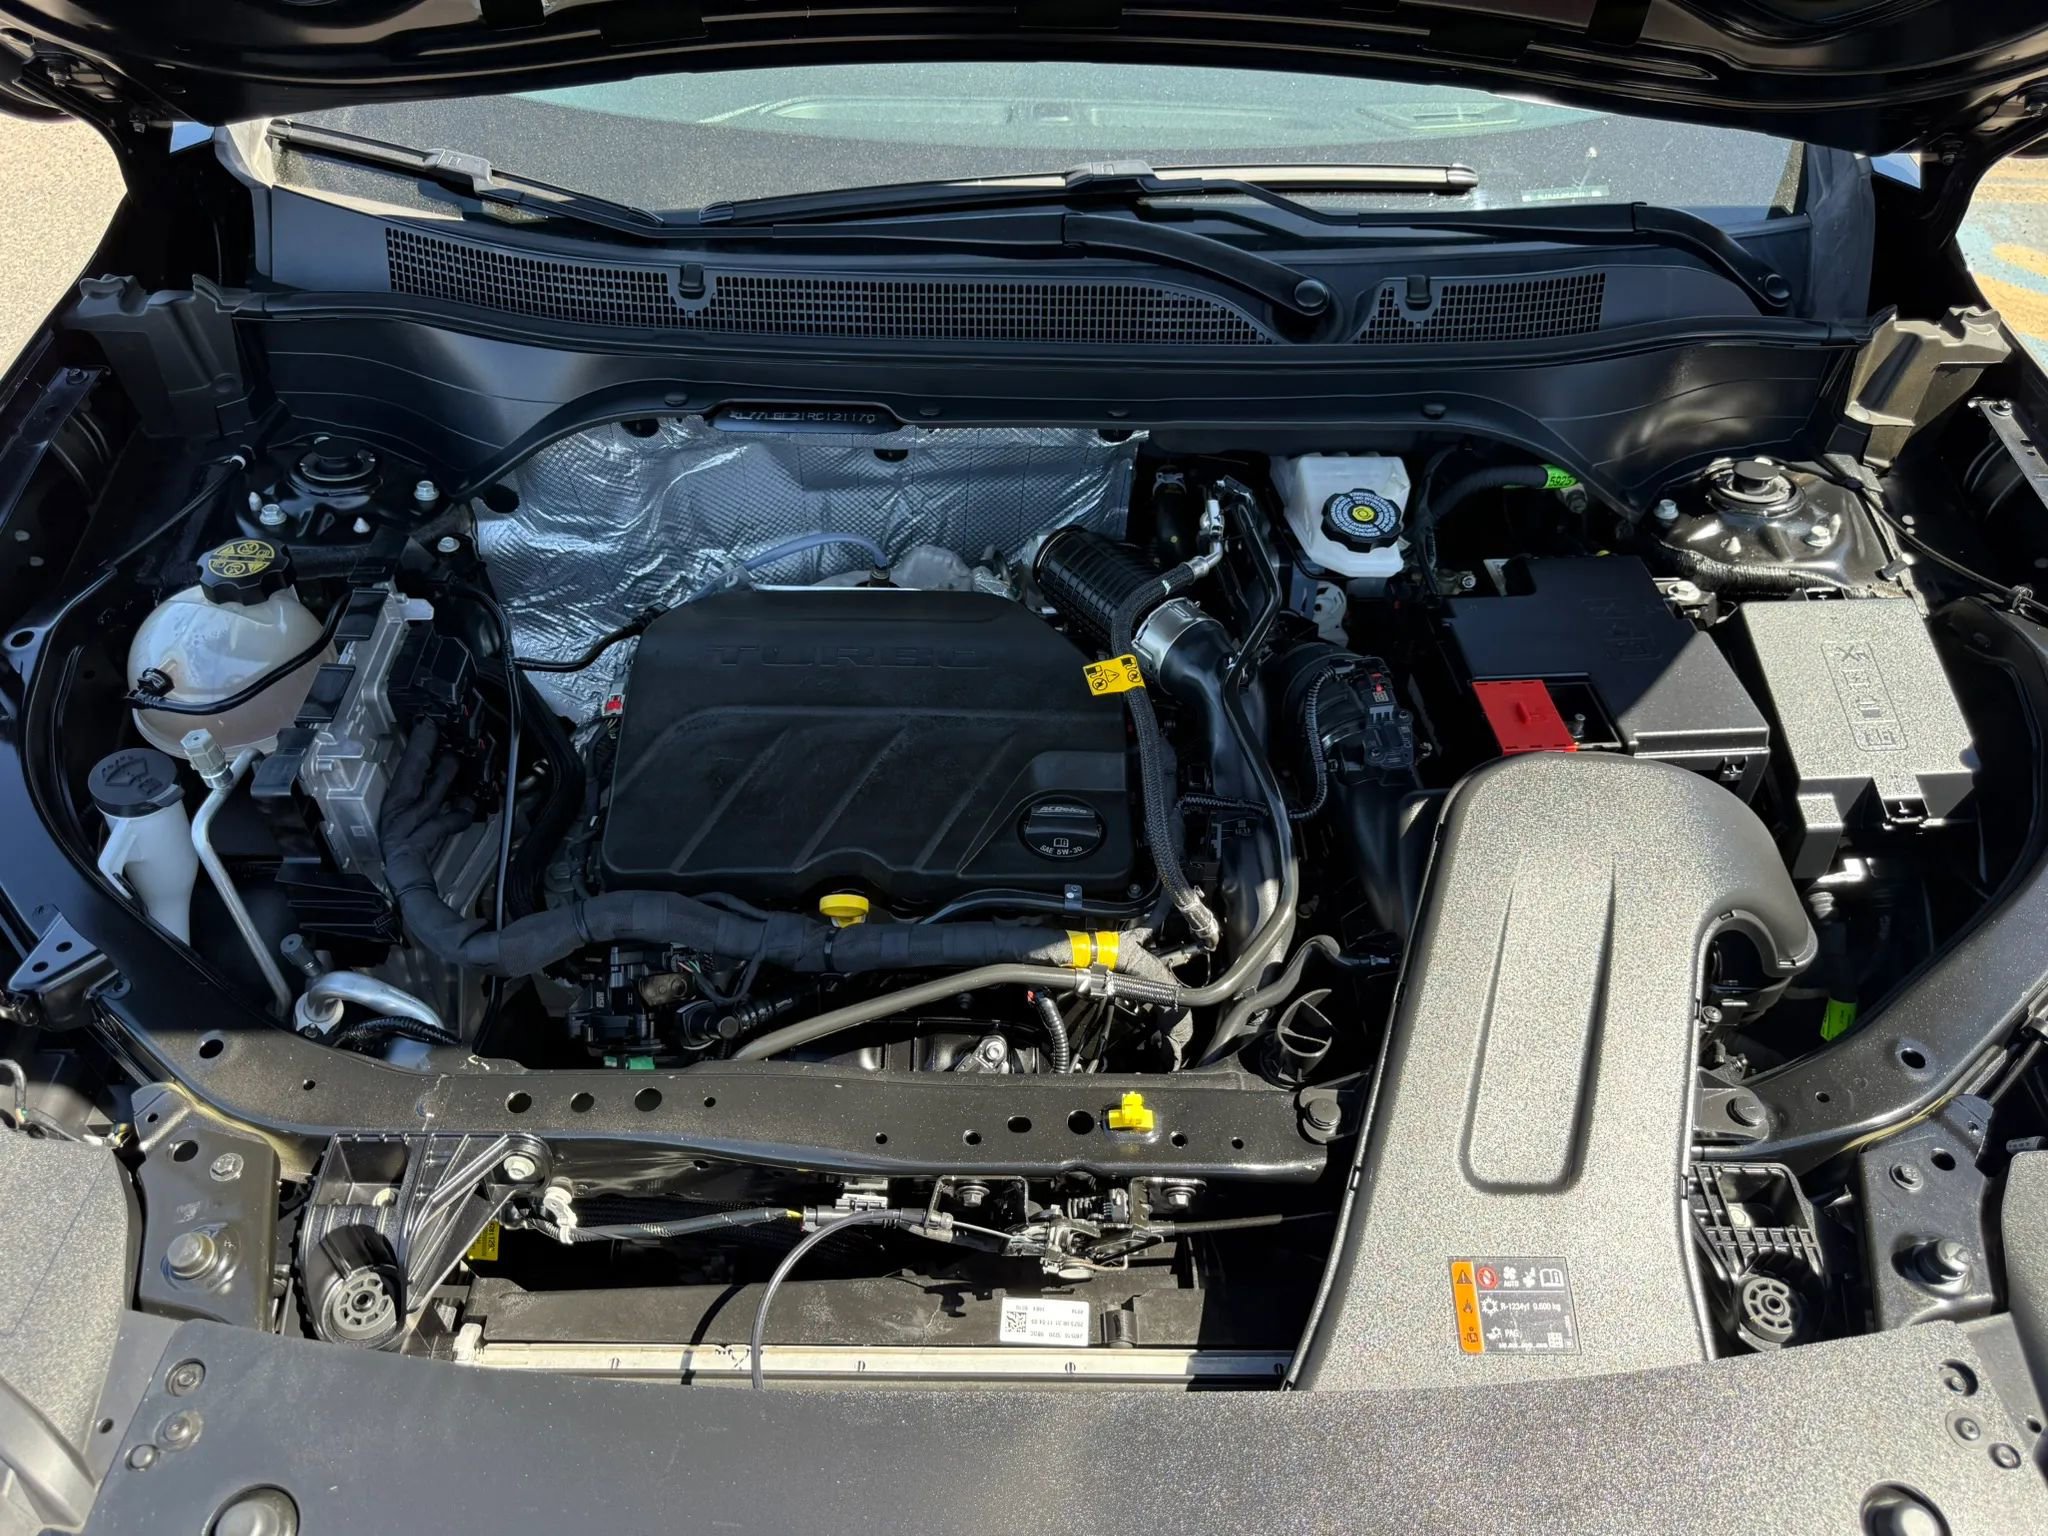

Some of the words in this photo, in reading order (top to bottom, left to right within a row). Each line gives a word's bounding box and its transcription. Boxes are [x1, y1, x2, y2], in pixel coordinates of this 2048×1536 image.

[702, 647, 992, 670] TURBO
[1037, 806, 1087, 814] ACDelco
[1040, 844, 1054, 854] SAE
[1503, 1280, 1519, 1288] AUTO
